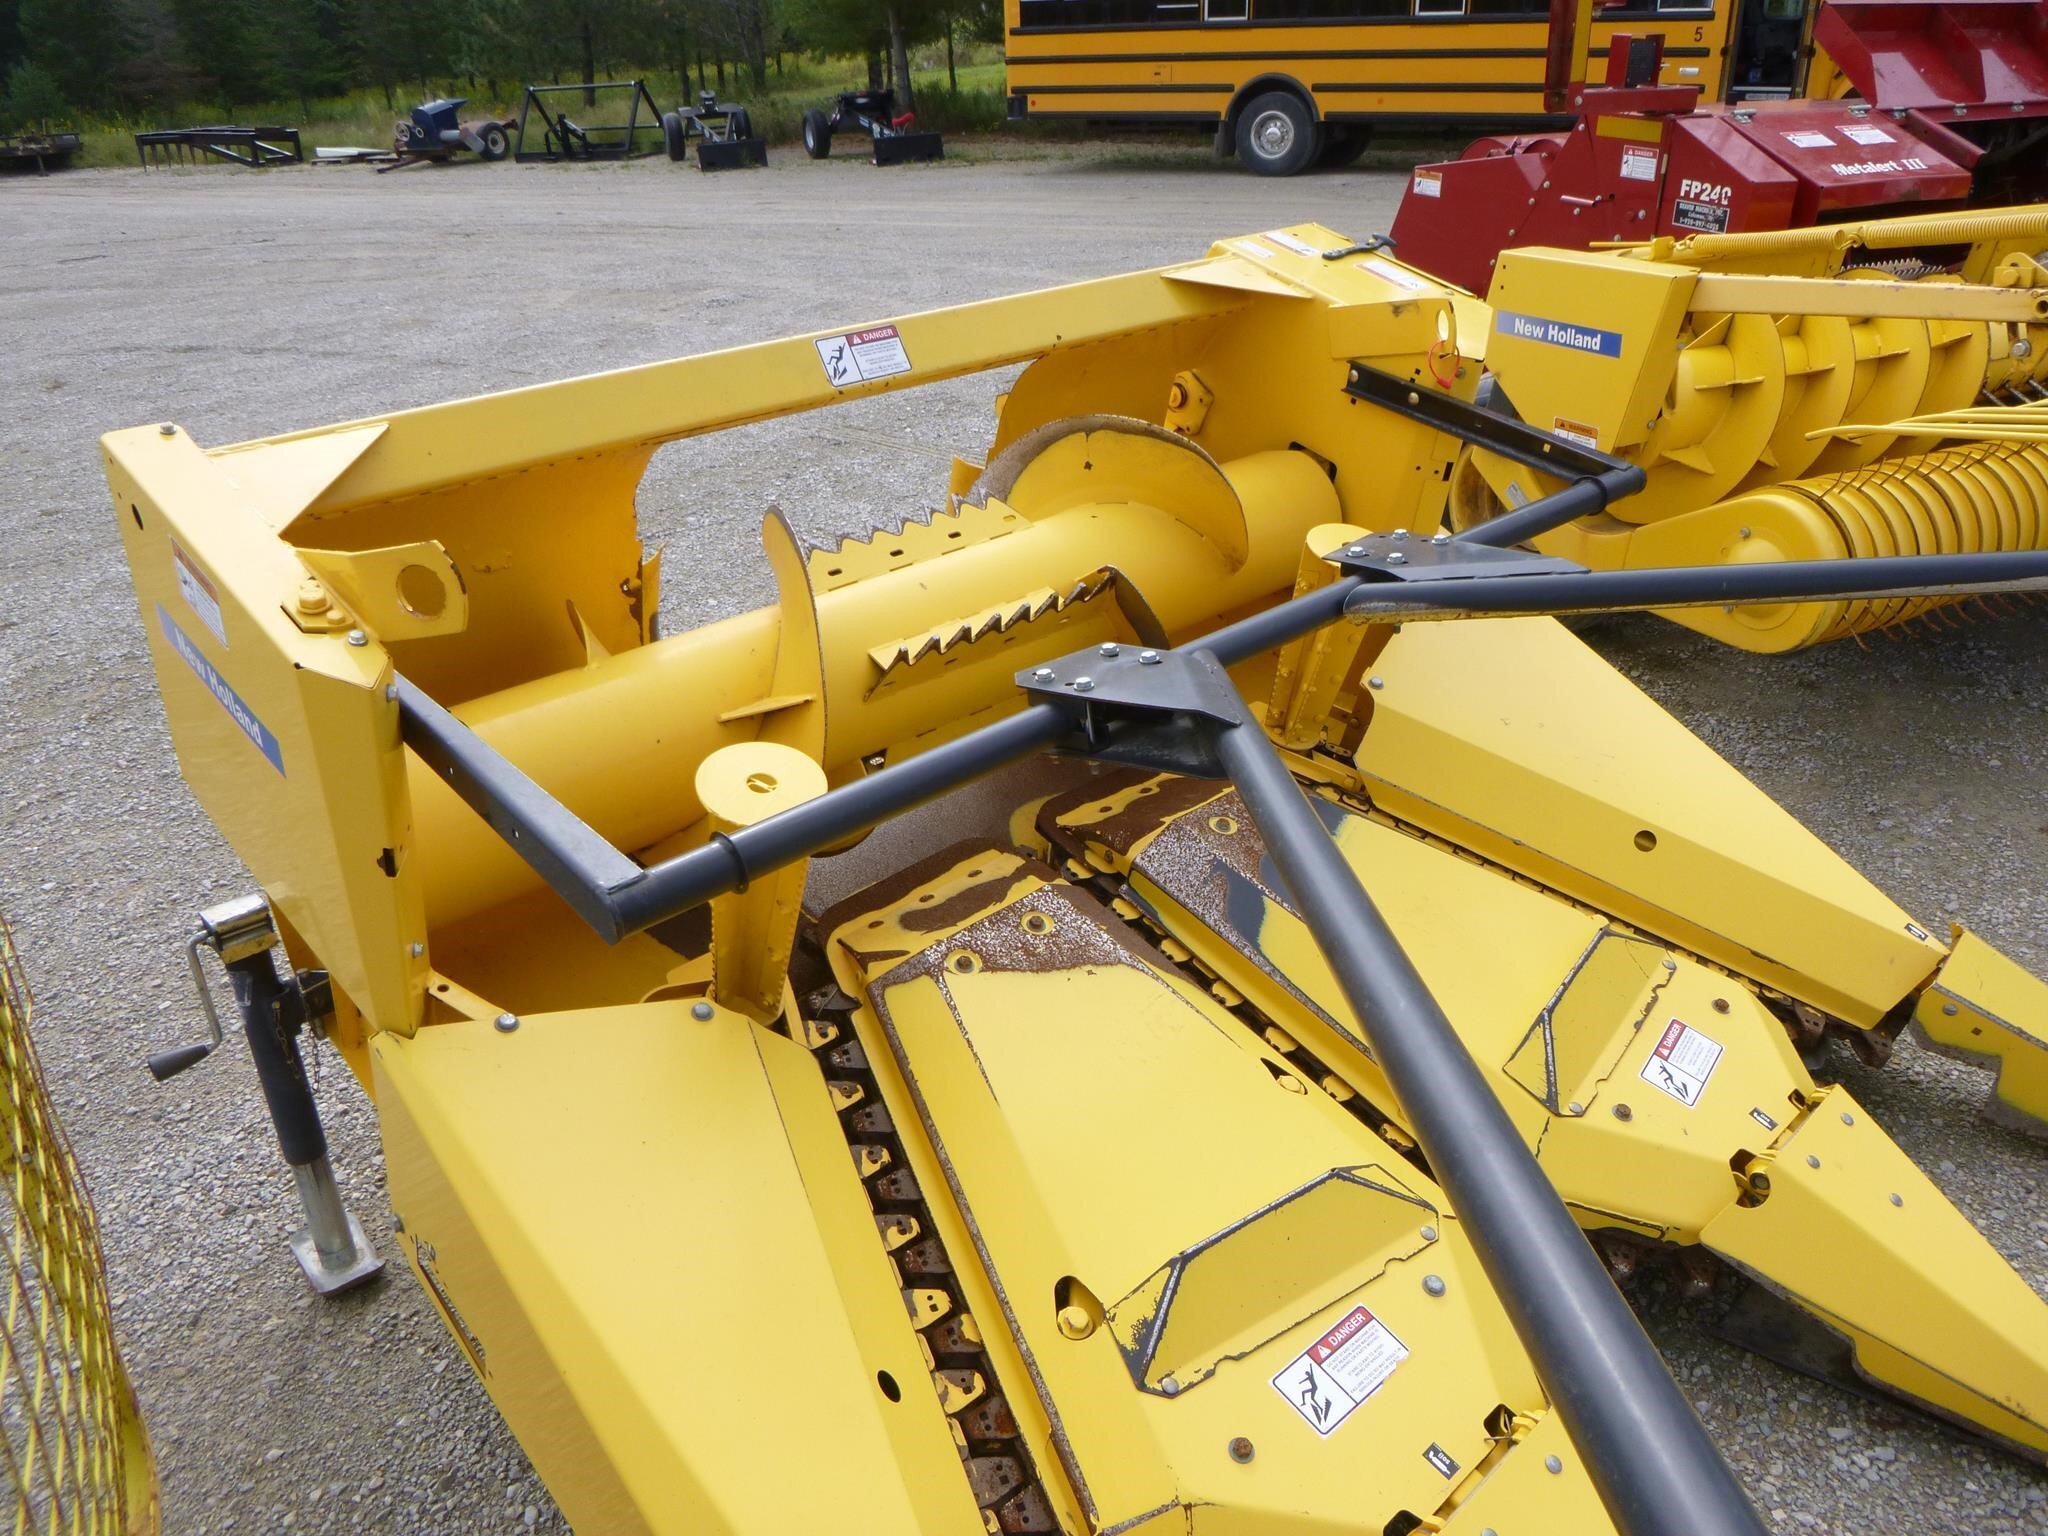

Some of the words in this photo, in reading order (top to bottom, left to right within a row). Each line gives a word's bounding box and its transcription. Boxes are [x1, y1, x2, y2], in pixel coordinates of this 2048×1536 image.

[1694, 26, 1703, 42] 5
[1831, 160, 1902, 176] Metalert
[1901, 158, 1928, 170] III
[862, 328, 894, 341] DANGER
[1514, 317, 1545, 339] New
[1547, 324, 1602, 351] Holland
[174, 627, 206, 679] New
[206, 665, 264, 748] Holland
[1664, 1023, 1682, 1047] DANGER
[1327, 1312, 1366, 1347] DANGER
